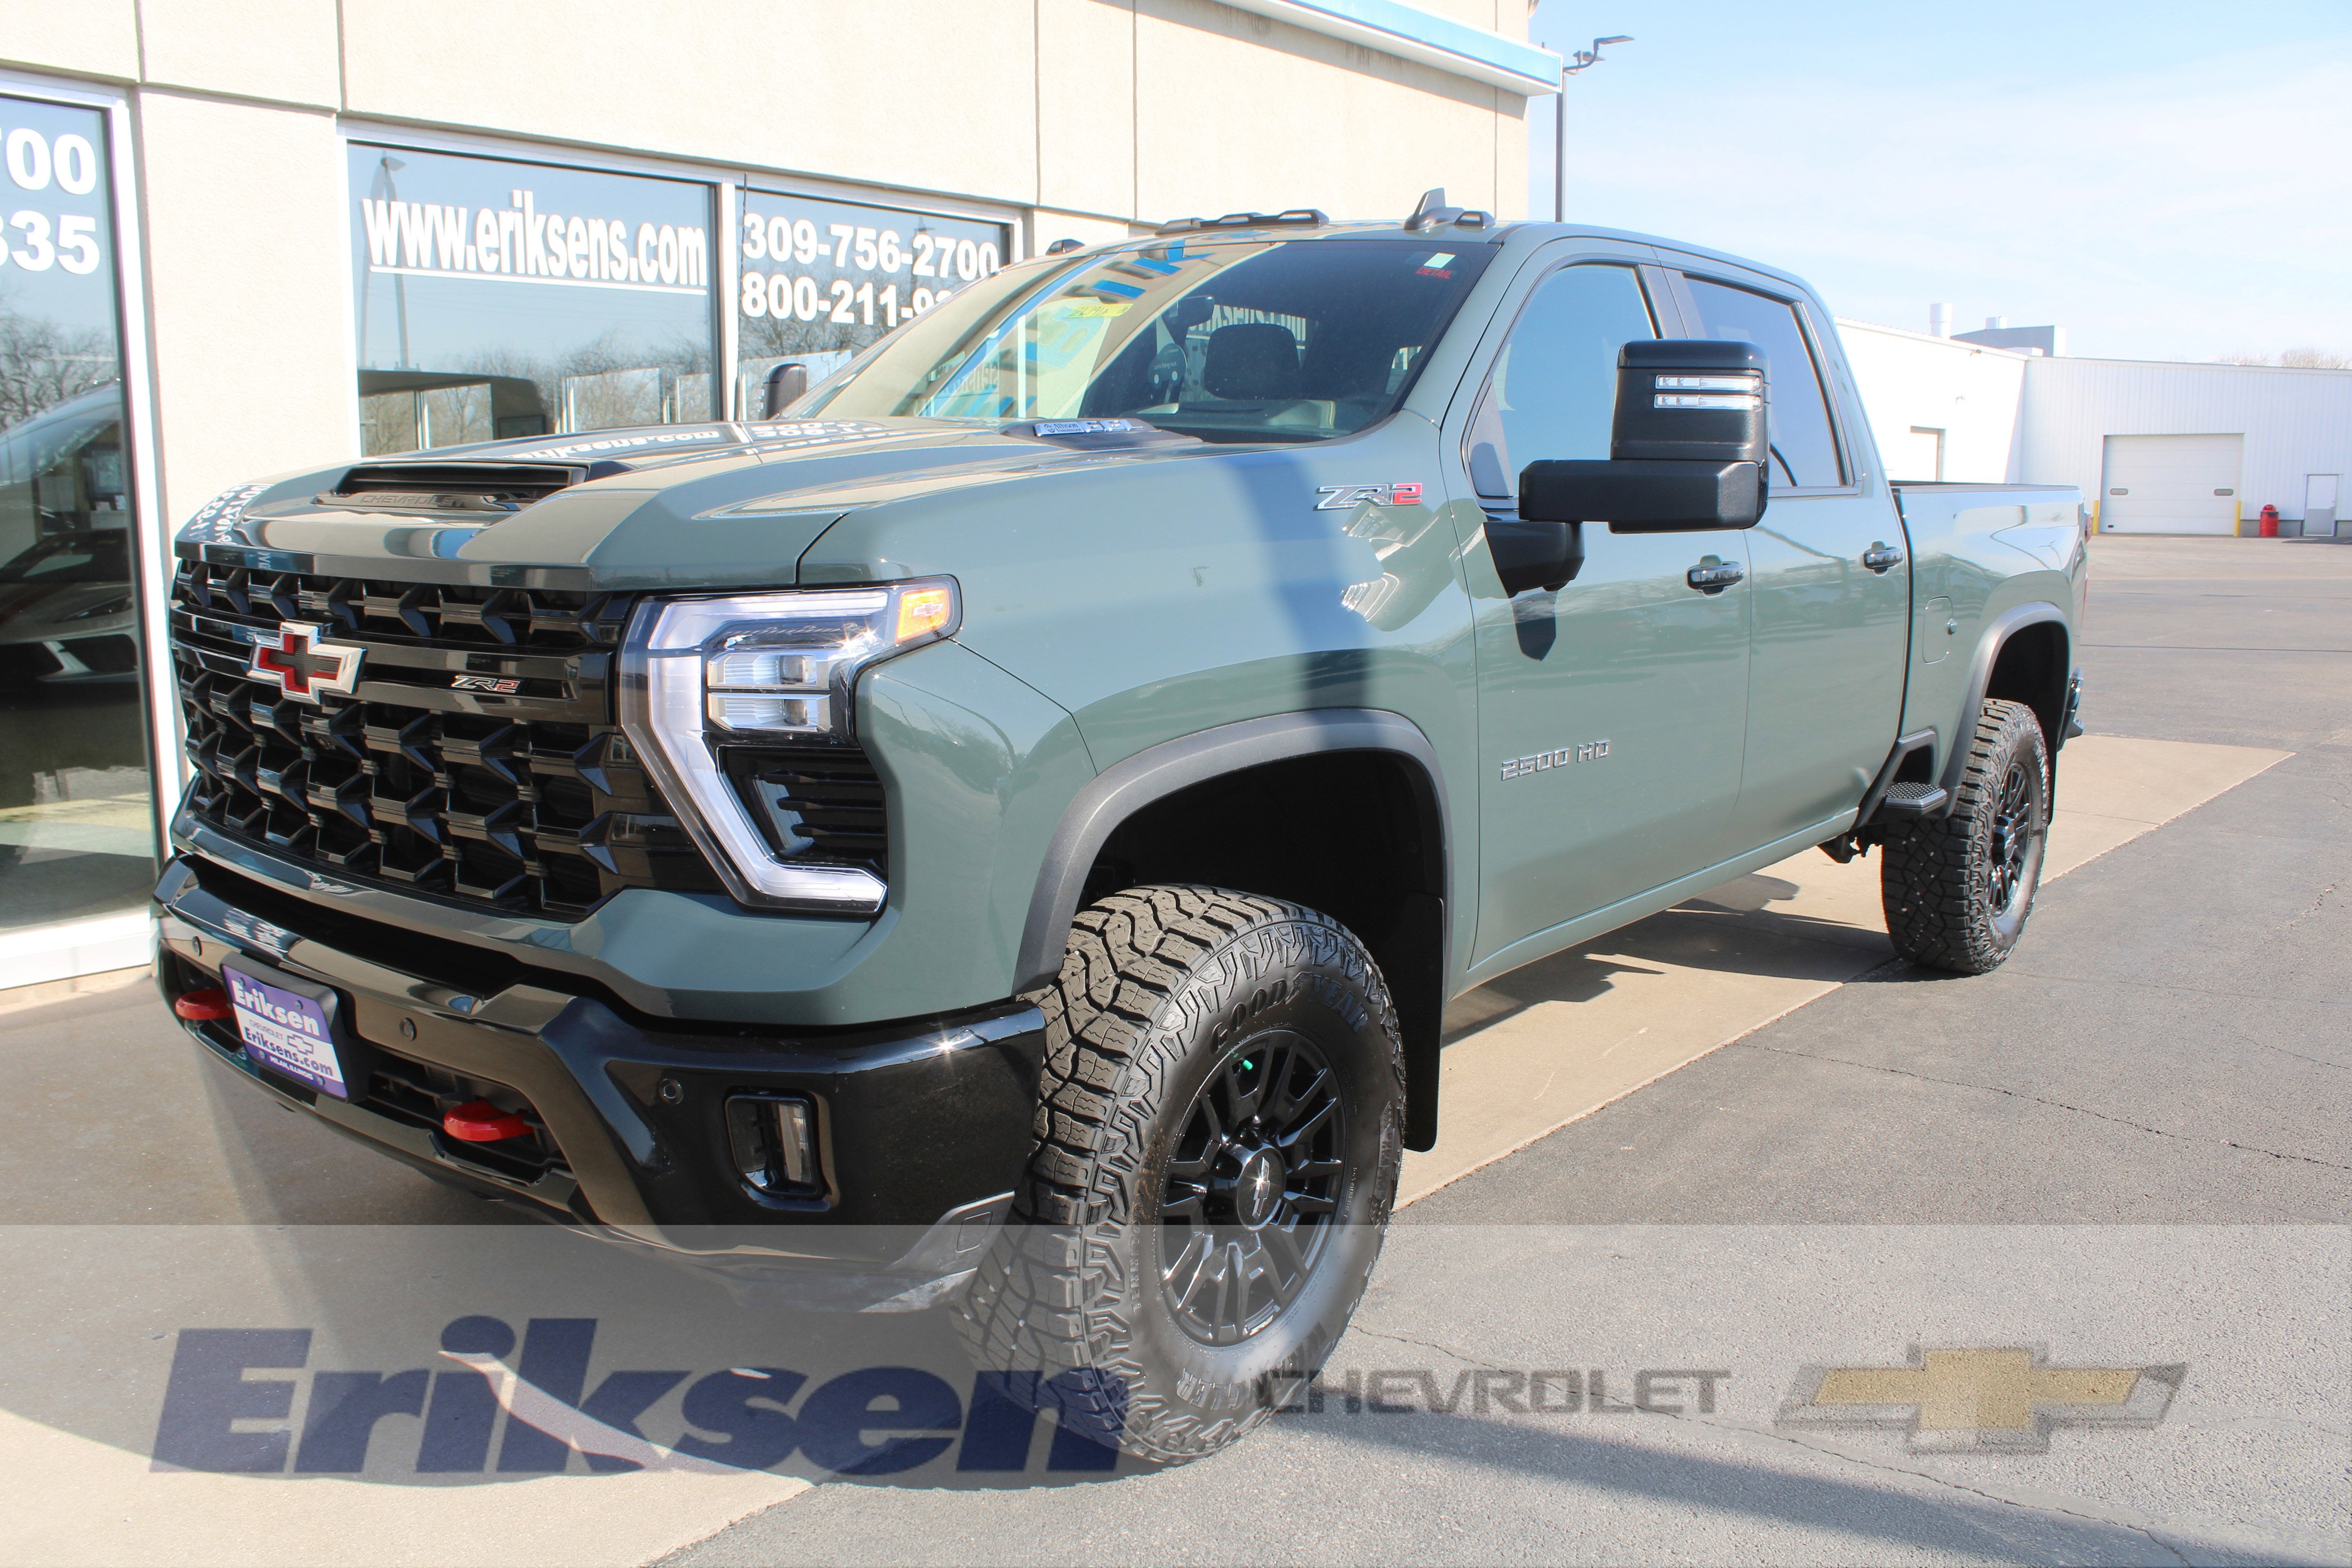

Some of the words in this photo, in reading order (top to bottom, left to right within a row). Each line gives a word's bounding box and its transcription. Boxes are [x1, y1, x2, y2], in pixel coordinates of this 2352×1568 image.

[362, 189, 708, 286] www.eriksens.com
[742, 213, 999, 281] 309-756-2700
[1416, 266, 1453, 279] DETAIL
[742, 271, 952, 327] 800-211-9
[361, 494, 466, 508] CHEVROLET
[1313, 483, 1422, 511] ZR2
[451, 675, 521, 693] ZR2
[1501, 747, 1570, 781] 2500
[1577, 738, 1610, 763] HD
[230, 979, 320, 1037] Eriksen
[249, 1019, 284, 1040] CHEVROLET
[1210, 971, 1369, 1054] GOODYEAR
[244, 1025, 334, 1077] Eriksens.com
[1176, 1320, 1328, 1411] WRANGLER
